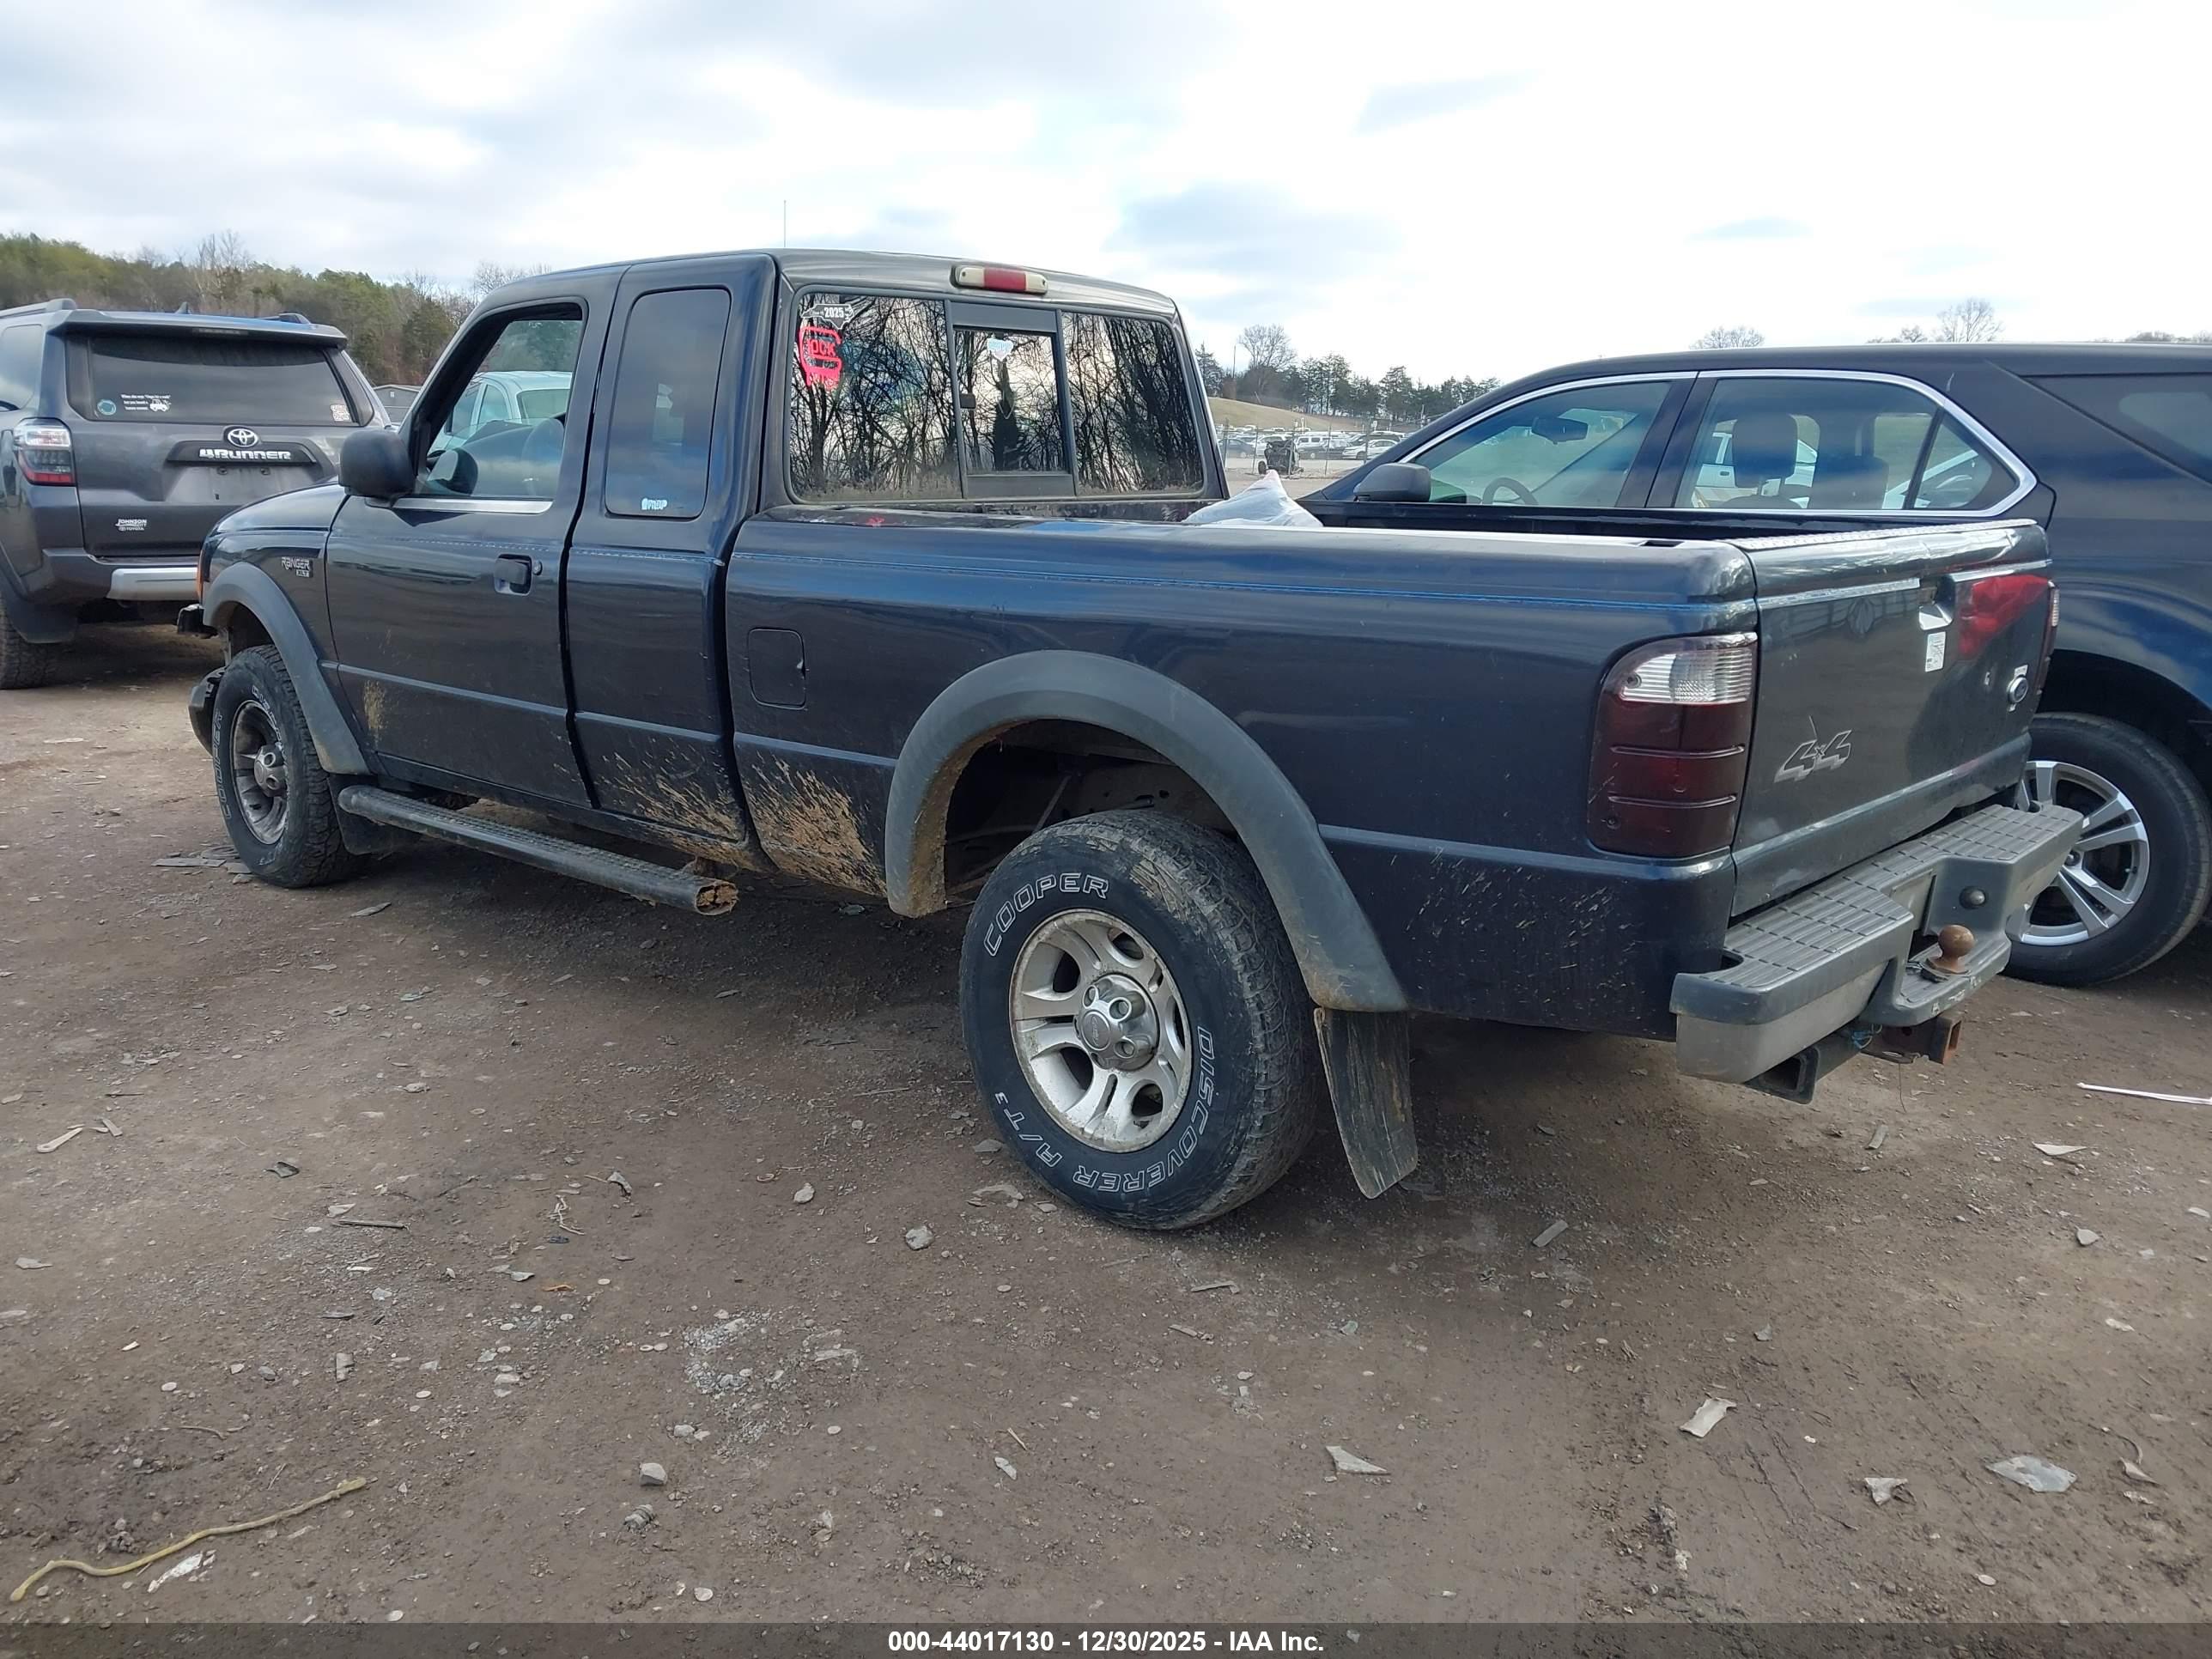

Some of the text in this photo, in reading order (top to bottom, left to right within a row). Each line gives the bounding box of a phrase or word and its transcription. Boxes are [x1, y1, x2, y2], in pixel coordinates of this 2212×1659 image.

[824, 307, 844, 318] 2025
[281, 556, 310, 571] RANGER
[983, 872, 1109, 957] COOPER
[1073, 1025, 1215, 1193] DISCOVERER
